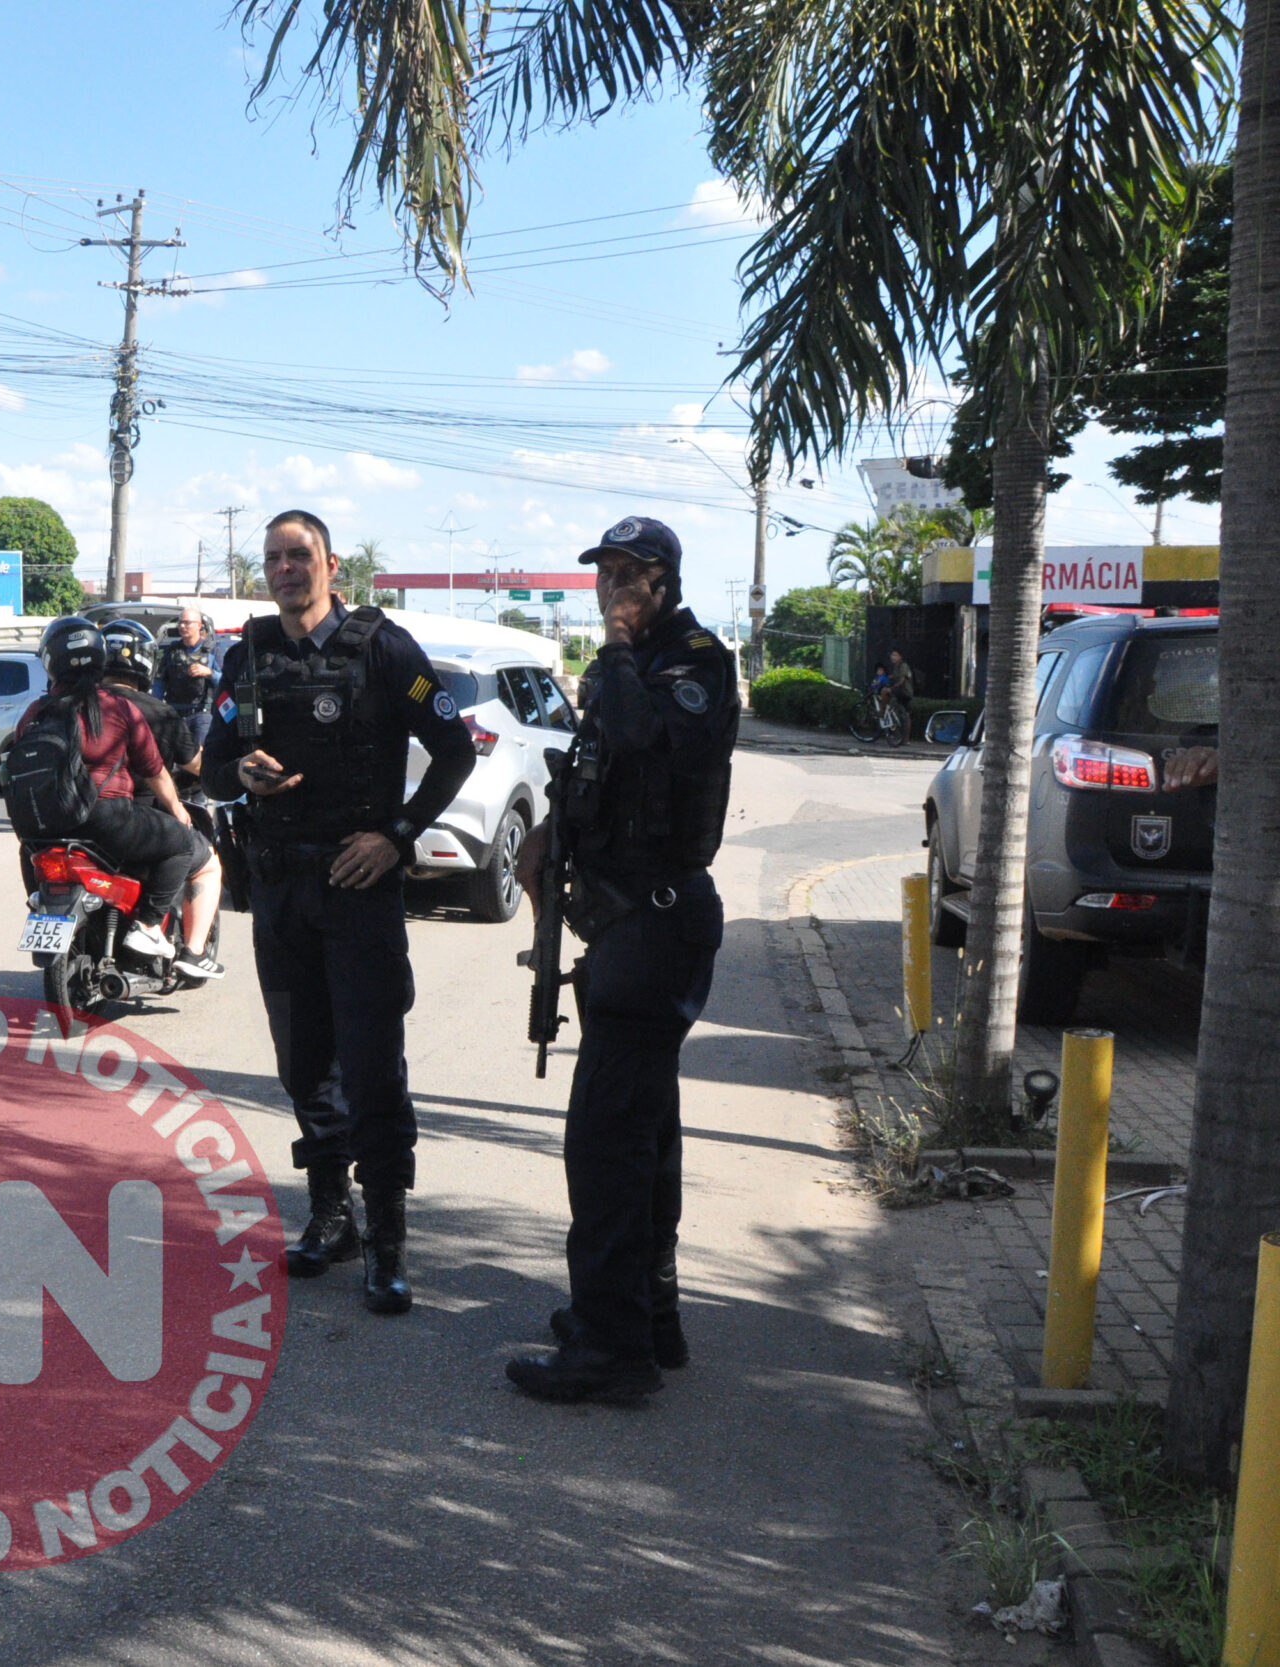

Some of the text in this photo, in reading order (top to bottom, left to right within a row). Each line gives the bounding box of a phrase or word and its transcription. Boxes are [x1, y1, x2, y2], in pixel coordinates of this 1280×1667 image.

[1041, 556, 1138, 590] RMÁCIA
[33, 921, 63, 936] ELE
[25, 935, 62, 950] 9A24
